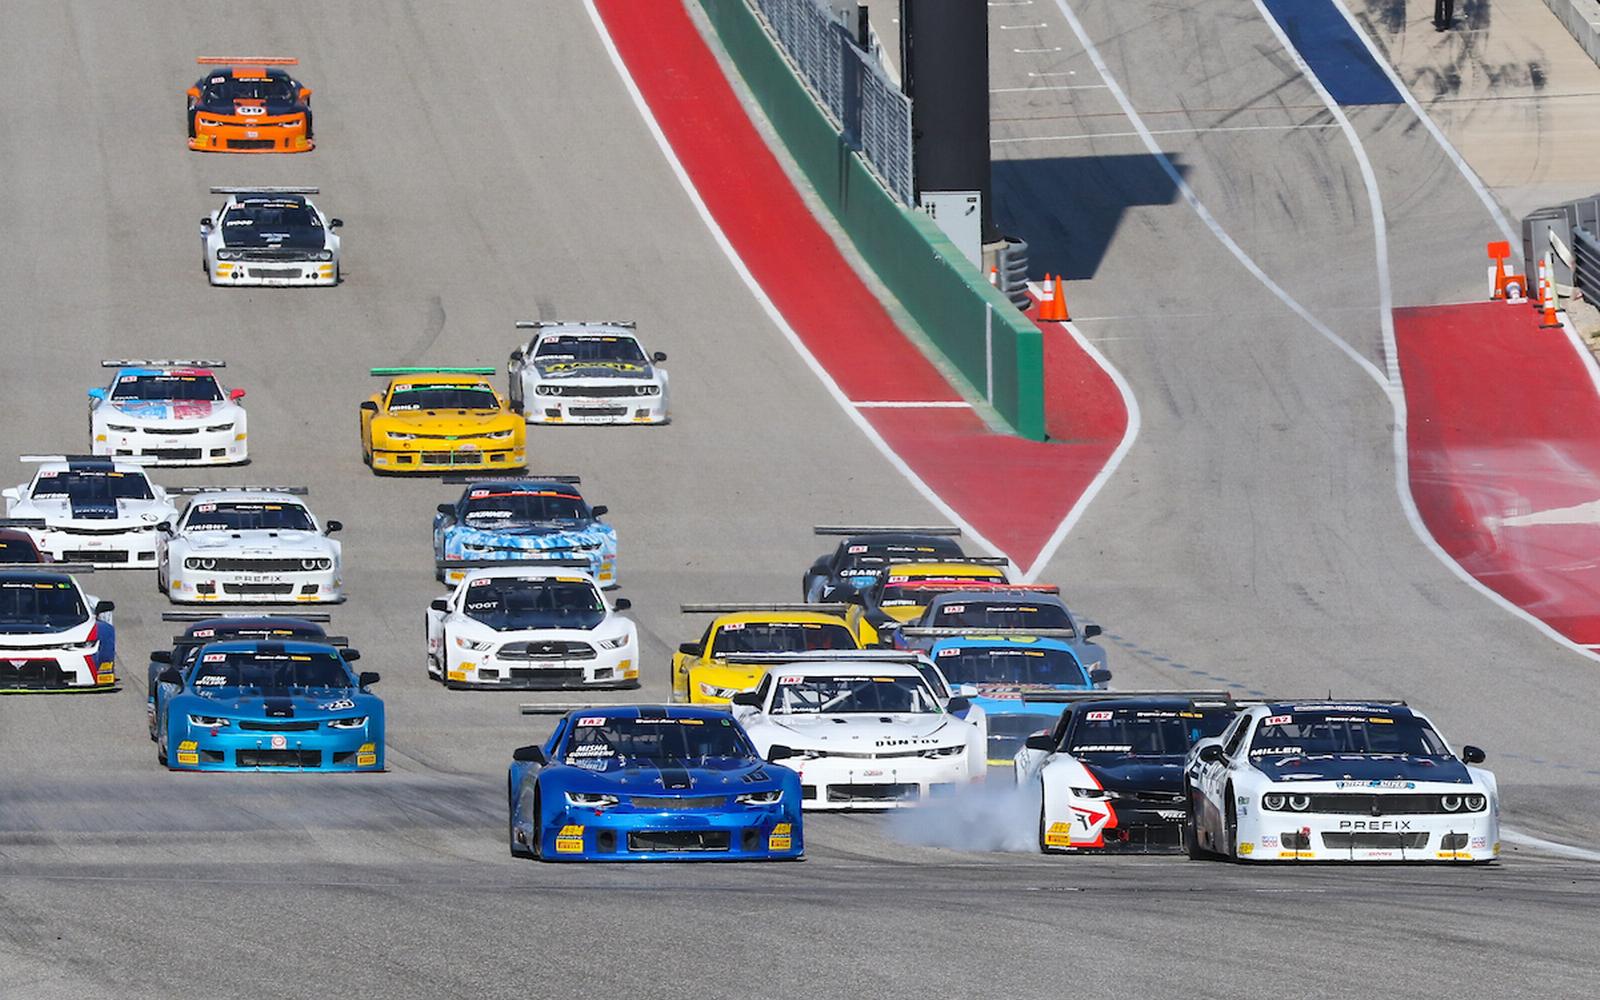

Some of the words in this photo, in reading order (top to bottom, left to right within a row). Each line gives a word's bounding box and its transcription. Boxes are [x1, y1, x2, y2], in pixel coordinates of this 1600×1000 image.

[466, 510, 512, 519] SKINNER
[468, 601, 499, 610] VOGT
[875, 739, 939, 747] DUNTOV
[576, 744, 608, 752] MISHA
[1250, 747, 1302, 756] MILLER
[1340, 821, 1411, 830] PREFIX
